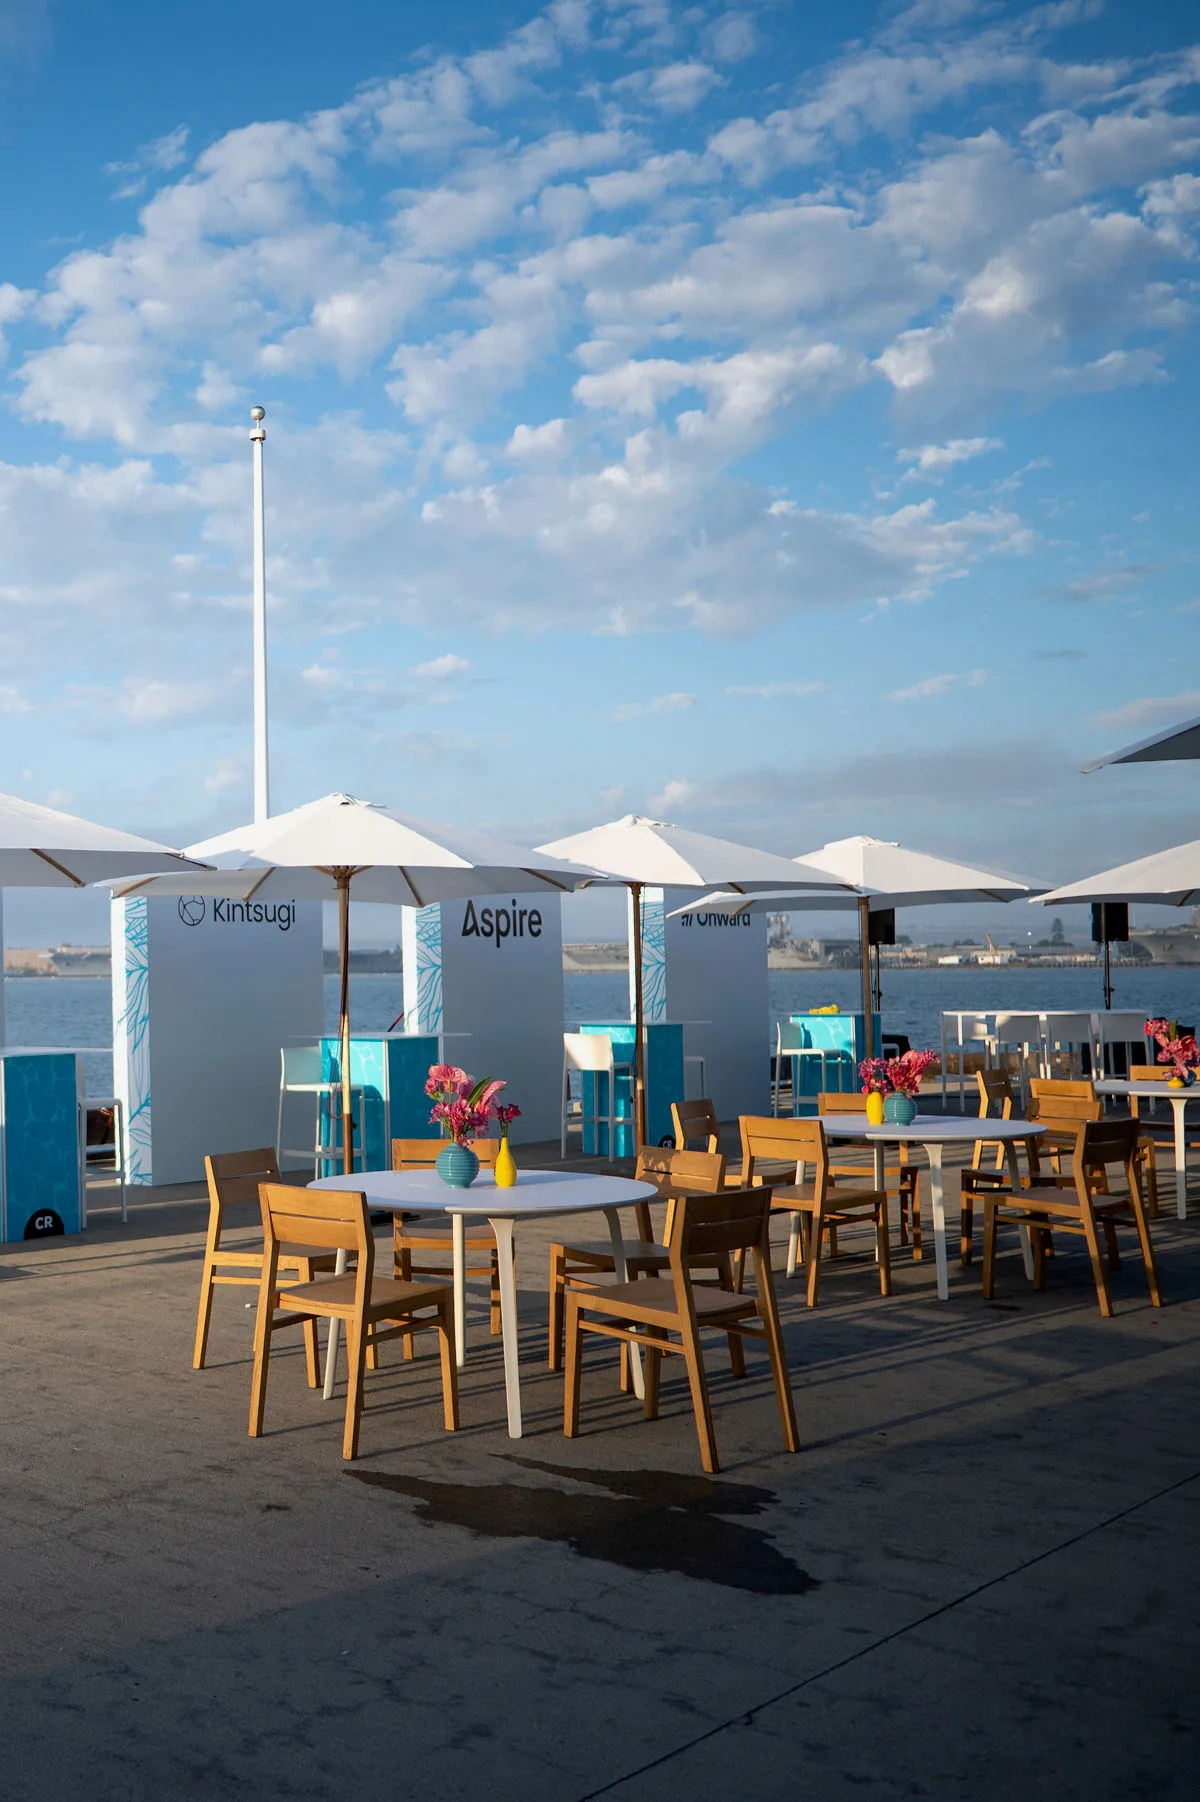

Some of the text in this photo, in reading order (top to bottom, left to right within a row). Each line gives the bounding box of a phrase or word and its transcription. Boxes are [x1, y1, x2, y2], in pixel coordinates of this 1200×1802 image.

[213, 898, 295, 931] Kintsugi
[461, 898, 542, 948] Aspire
[35, 1215, 53, 1230] CR
